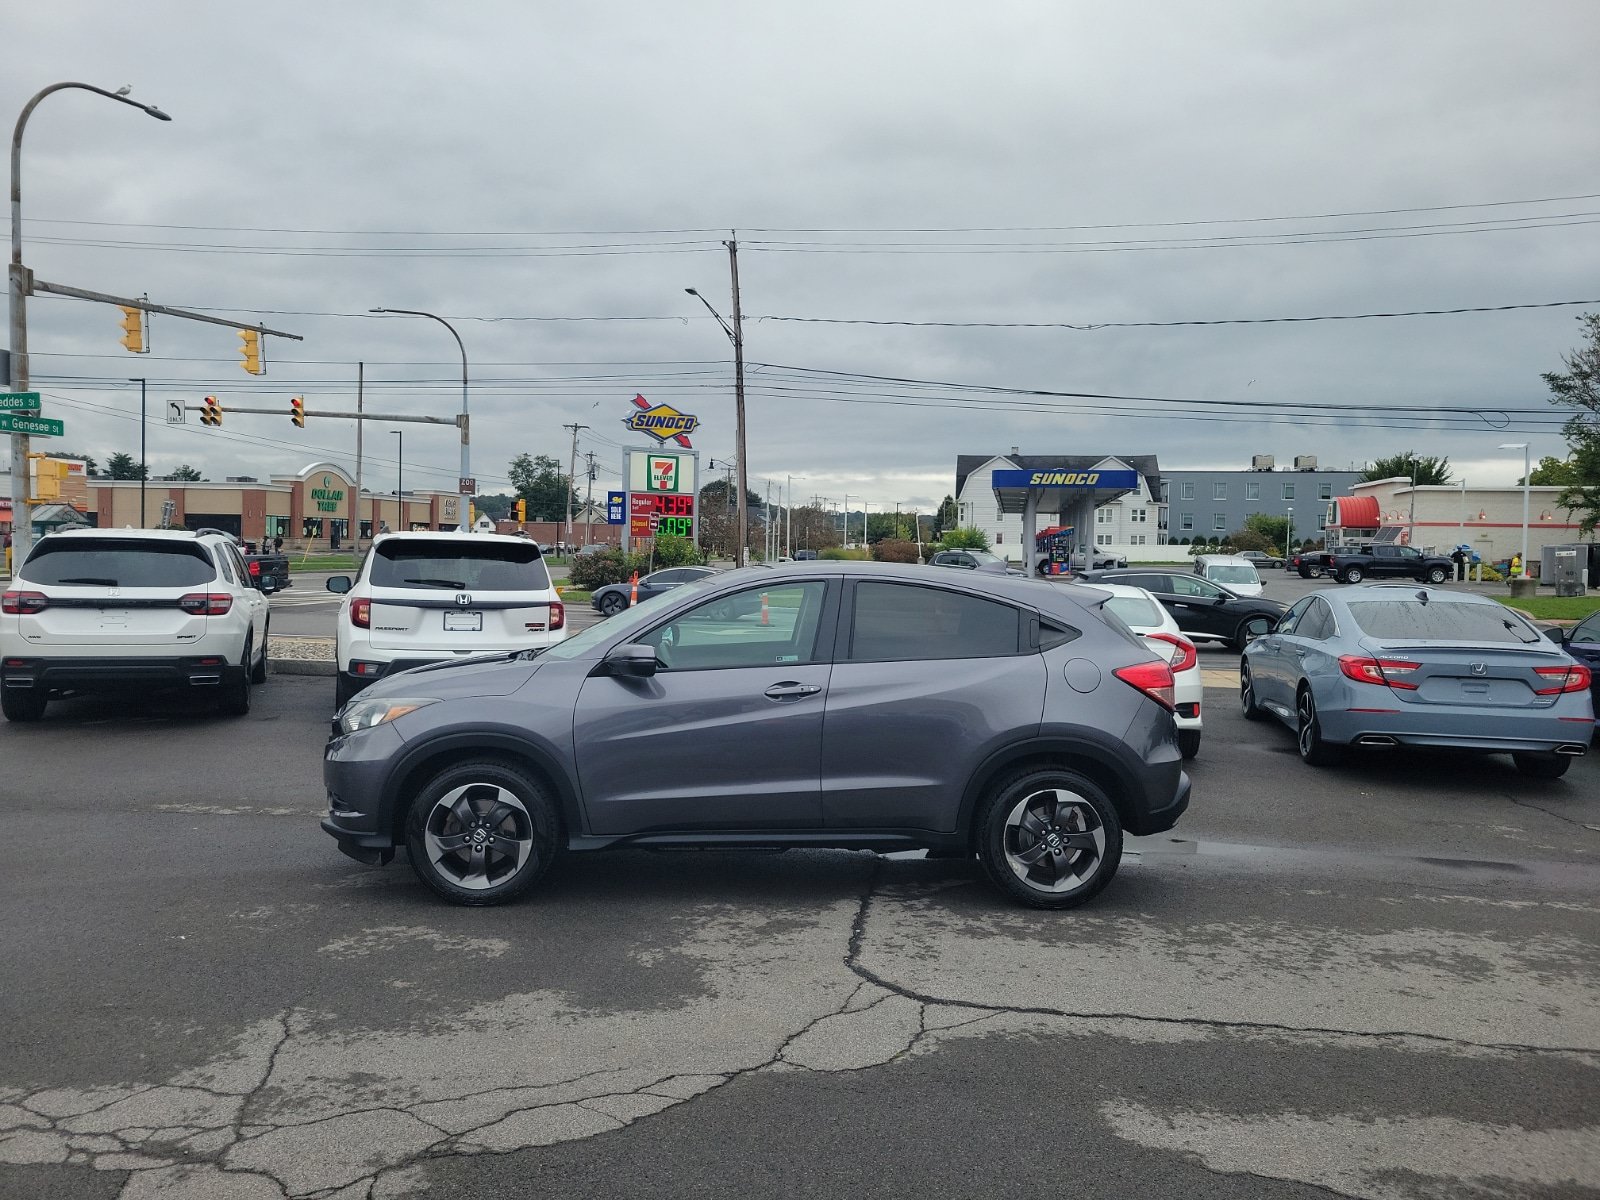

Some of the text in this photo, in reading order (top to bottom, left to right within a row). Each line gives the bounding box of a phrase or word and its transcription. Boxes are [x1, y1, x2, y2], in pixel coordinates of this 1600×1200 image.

[11, 418, 50, 432] Genesee
[635, 414, 696, 430] SUNOCO
[1029, 473, 1100, 485] SUNOCO
[311, 488, 343, 501] DOLLAR
[317, 501, 338, 512] TREE
[632, 497, 652, 506] Regular
